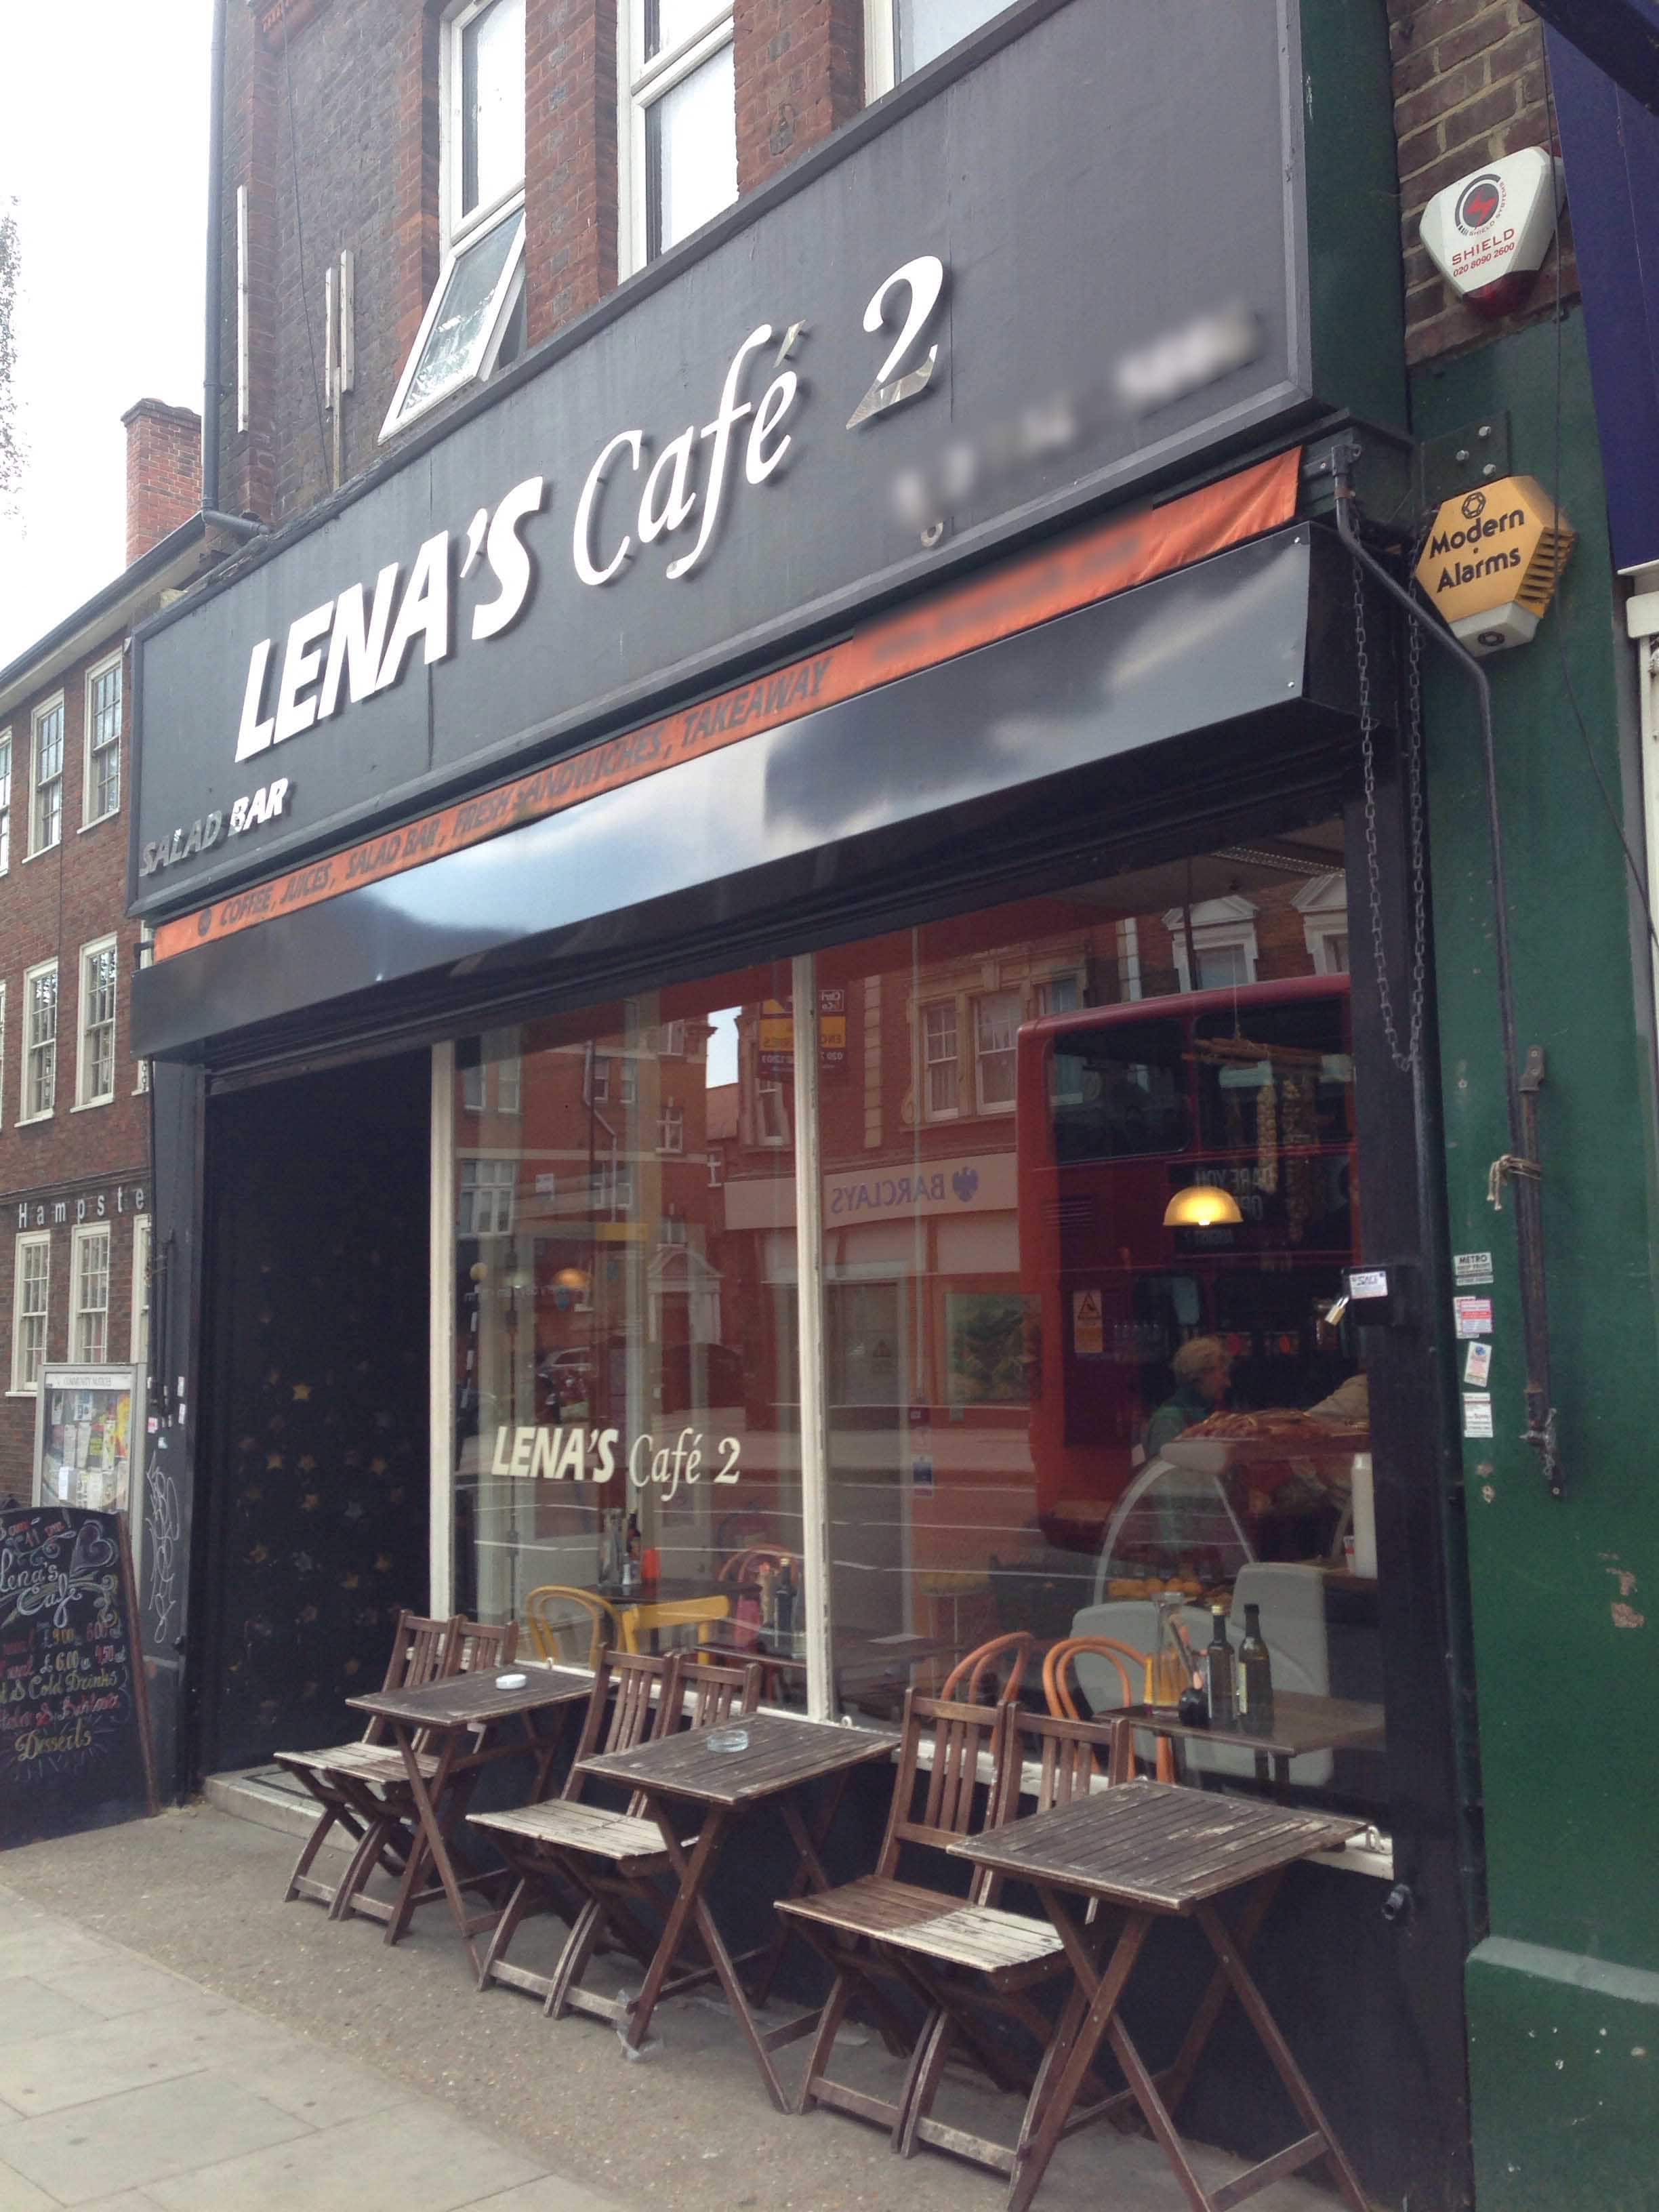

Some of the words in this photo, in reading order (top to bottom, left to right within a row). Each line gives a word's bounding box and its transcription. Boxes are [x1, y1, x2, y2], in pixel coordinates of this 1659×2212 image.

[1452, 228, 1515, 265] SHIELD
[1469, 220, 1495, 237] SHIELD
[1453, 264, 1469, 277] 020
[1471, 253, 1492, 269] 8090
[1494, 242, 1515, 258] 2600
[234, 475, 544, 763] LENA'S
[573, 318, 807, 586] Café
[845, 255, 945, 431] 2
[1429, 509, 1525, 559] Modern
[1437, 547, 1521, 594] Alarms
[346, 834, 401, 880] SALAD
[453, 791, 513, 837] FRESH
[682, 655, 835, 749] TAKEAWAY
[139, 809, 223, 878] SALAD
[228, 777, 289, 838] BAR
[1458, 1254, 1488, 1264] METRO
[491, 1425, 619, 1483] LENA'S
[628, 1427, 703, 1502] Café
[714, 1436, 741, 1485] 2
